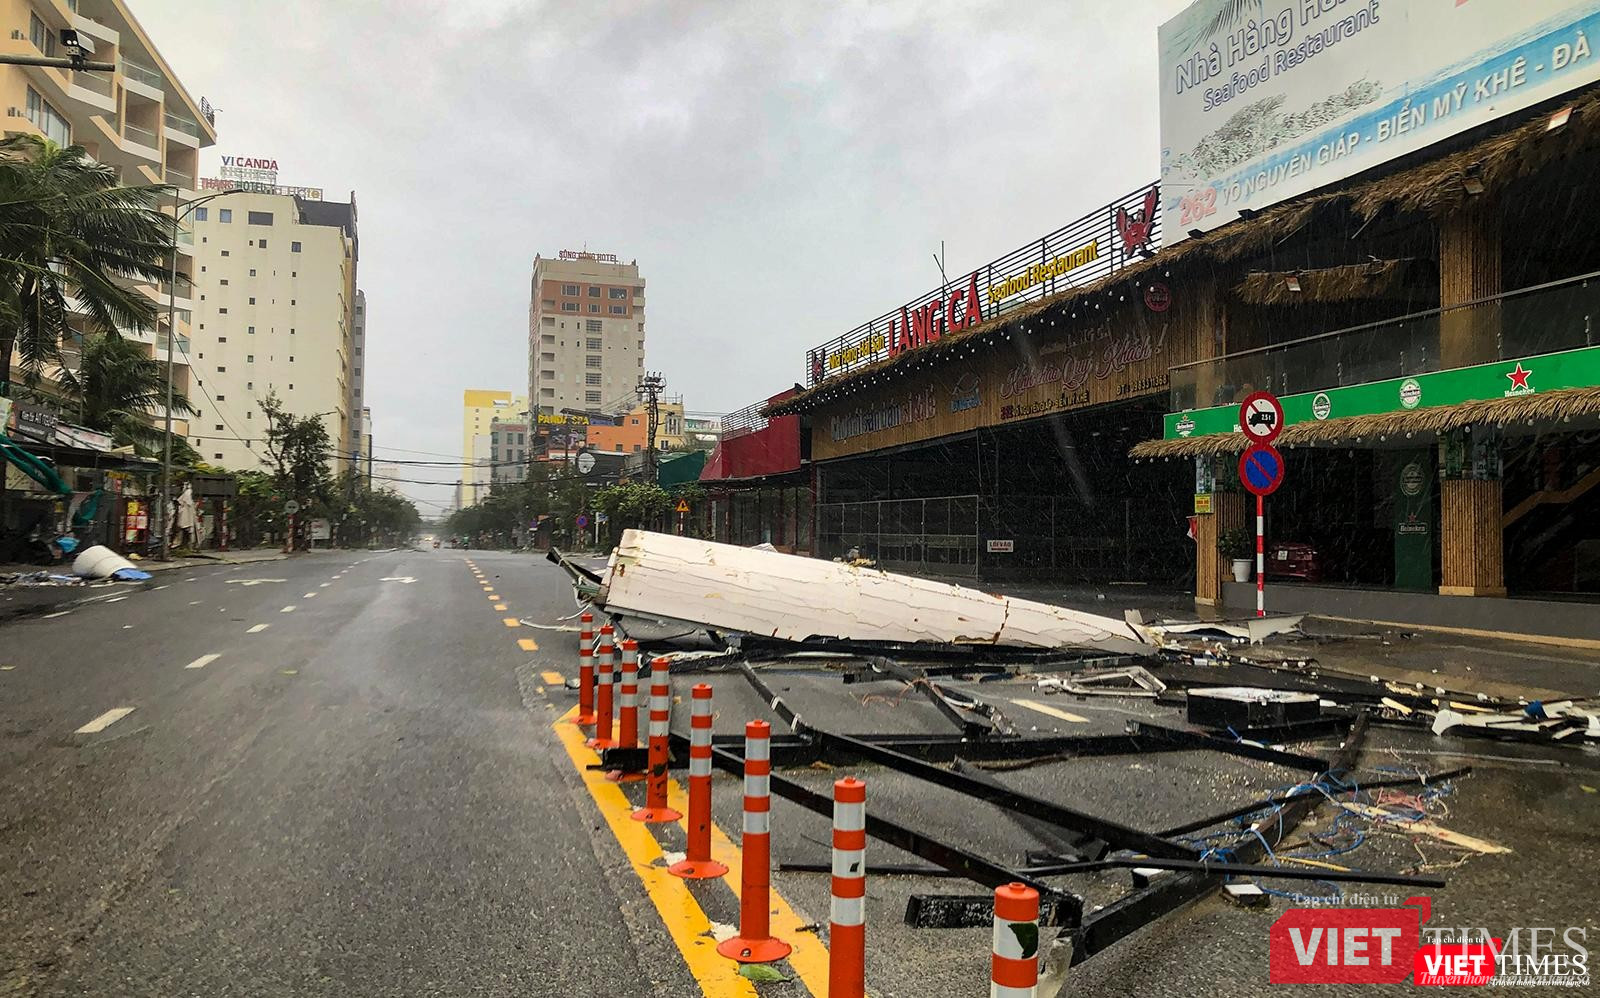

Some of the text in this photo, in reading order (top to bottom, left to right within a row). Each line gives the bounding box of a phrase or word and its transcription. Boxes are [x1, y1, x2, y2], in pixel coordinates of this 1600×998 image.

[1176, 42, 1222, 94] Nhà
[1226, 8, 1293, 67] Hàng
[1203, 1, 1380, 112] Seafood Restaurant
[1179, 187, 1217, 226] 262
[1317, 131, 1361, 165] GIÁP
[1377, 98, 1427, 142] BIỂN
[1433, 81, 1469, 120] MỸ
[1473, 55, 1527, 103] KHÊ
[1551, 30, 1592, 71] ĐÀ
[596, 253, 618, 263] HOTEL
[987, 239, 1099, 305] Seafood Restaurant
[888, 271, 982, 358] LÀNG CÁ
[1505, 387, 1536, 398] Heineken
